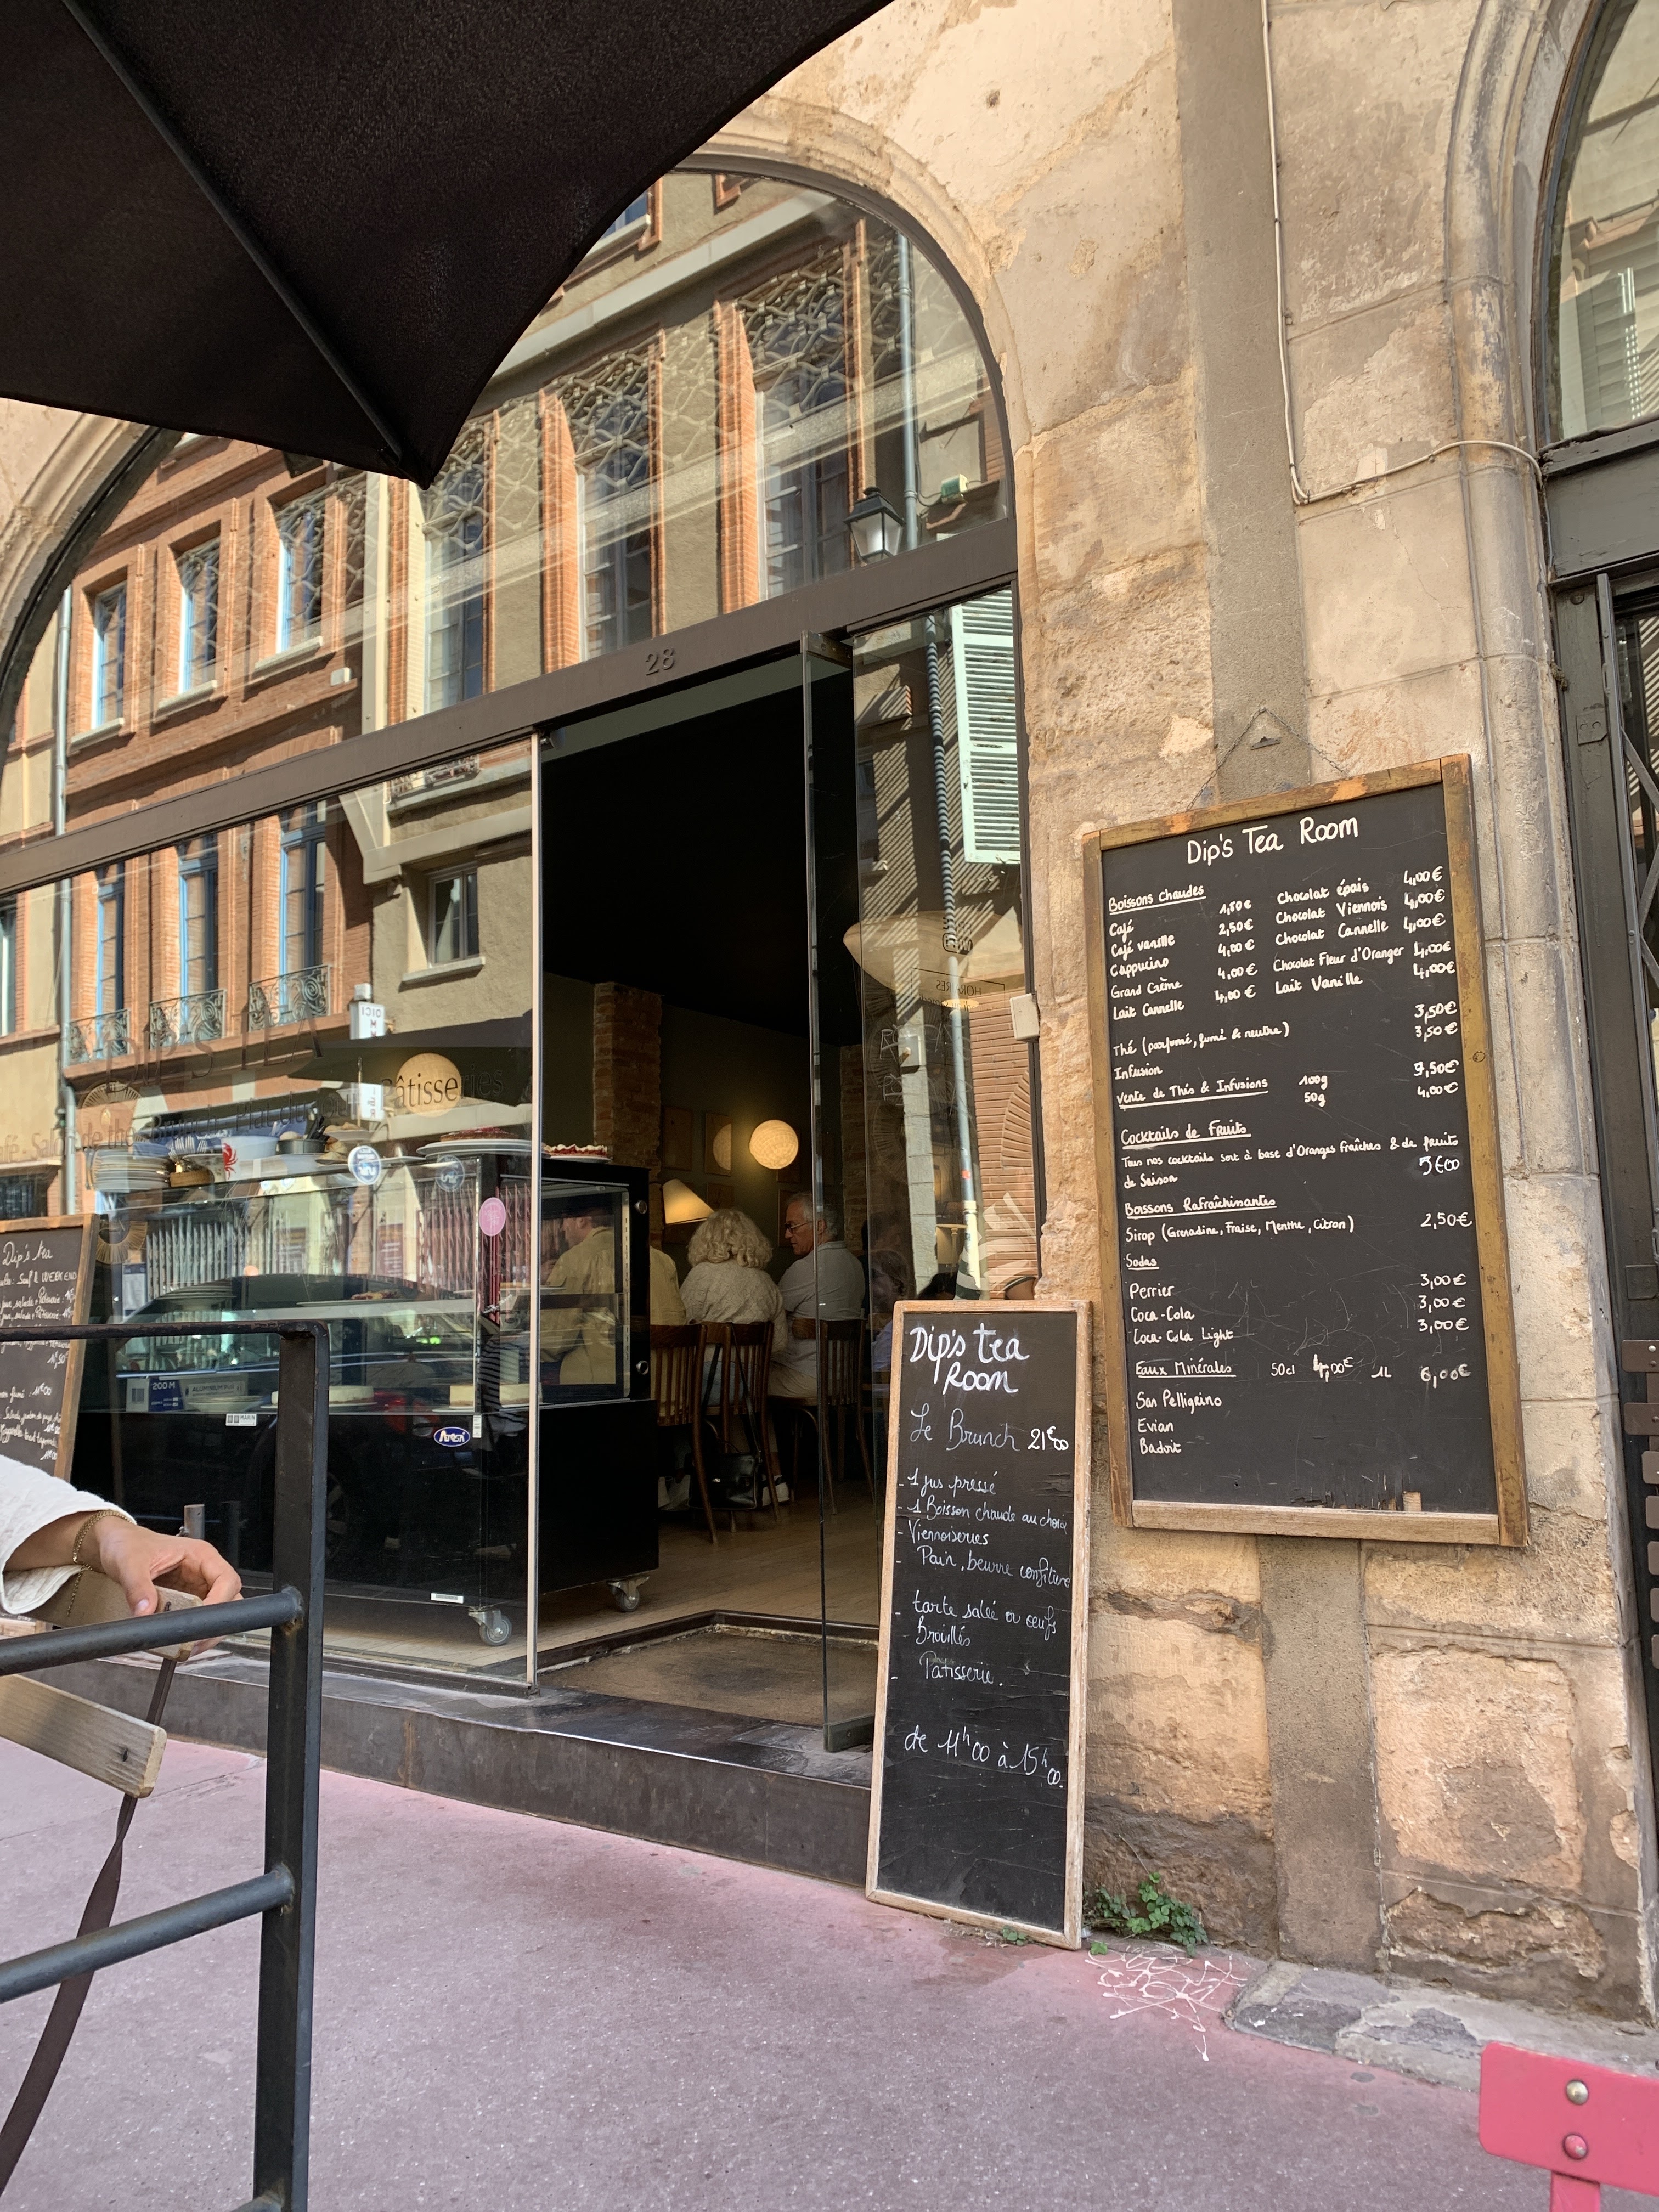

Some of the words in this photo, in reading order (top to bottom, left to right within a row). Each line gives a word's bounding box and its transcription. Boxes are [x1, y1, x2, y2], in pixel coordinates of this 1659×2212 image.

[646, 648, 675, 676] 28
[1187, 833, 1233, 866] Dip's
[1242, 824, 1284, 855] Tea
[1300, 816, 1359, 845] Room
[1108, 894, 1154, 912] Boissons
[1158, 884, 1205, 902] chaudes
[1277, 887, 1330, 905] Chocolat
[1336, 877, 1370, 898] épais
[1403, 866, 1443, 887] 4,00€
[1276, 907, 1326, 925] Chocolat
[1335, 896, 1388, 917] Viennois
[1403, 888, 1446, 910] 4,00€
[1109, 918, 1135, 943] Café
[1111, 940, 1135, 961] Café
[1218, 918, 1254, 937] 2,50€
[1275, 928, 1325, 946] Chocolat
[1338, 919, 1389, 938] Cannelle
[1403, 912, 1447, 934] 4,00€
[1218, 939, 1255, 958] 4,00€
[1273, 957, 1316, 973] Chocolat
[1318, 951, 1347, 967] Fleur
[1350, 946, 1404, 965] d'Oranger
[1413, 940, 1452, 959] 4,00€
[1111, 984, 1142, 999] Grand
[1217, 963, 1259, 980] 4,00€
[1275, 979, 1302, 995] Lait
[1311, 972, 1364, 992] Vanille
[1413, 961, 1456, 980] 4,00€
[1113, 1005, 1137, 1021] Lait
[1142, 1000, 1185, 1017] Cannelle
[1214, 985, 1257, 1005] 4,00€
[1113, 1040, 1138, 1057] Thé
[1231, 1028, 1242, 1040] &
[1414, 1001, 1458, 1025] 3,50€
[1114, 1062, 1164, 1080] Infusion
[1414, 1022, 1459, 1043] 3,50€
[1117, 1092, 1147, 1105] Vente
[1153, 1087, 1165, 1099] de
[1169, 1082, 1195, 1097] Thés
[1200, 1080, 1210, 1093] &
[1216, 1077, 1269, 1093] Infusions
[1298, 1074, 1329, 1090] 100g
[1304, 1091, 1327, 1107] 50g
[1417, 1081, 1459, 1098] 4,00€
[1120, 1125, 1180, 1146] Cocktails
[1185, 1123, 1201, 1139] de
[1121, 1156, 1143, 1169] Tous
[1146, 1156, 1164, 1166] nos
[1168, 1151, 1214, 1166] cocktails
[1244, 1148, 1253, 1160] à
[1257, 1147, 1282, 1160] base
[1285, 1144, 1336, 1160] d'Oranges
[1340, 1137, 1381, 1154] fraîches
[1390, 1136, 1400, 1150] &
[1402, 1136, 1417, 1148] de
[1124, 1173, 1137, 1189] de
[1125, 1227, 1155, 1246] Sirop
[1224, 1220, 1262, 1235] Fraise,
[1420, 1211, 1473, 1230] 2,50€
[1125, 1253, 1158, 1268] Sodas
[1130, 1282, 1175, 1300] Perrier
[1420, 1273, 1467, 1290] 3,00€
[1131, 1306, 1195, 1323] Coca-Cola
[1418, 1295, 1466, 1314] 3,00€
[1201, 1327, 1234, 1348] Light
[1417, 1317, 1470, 1334] 3,00€
[909, 1325, 966, 1385] Dip's
[972, 1322, 1030, 1364] tea
[941, 1361, 1019, 1395] Room
[1136, 1360, 1168, 1376] Eaux
[1175, 1357, 1232, 1375] Minérales
[1270, 1362, 1296, 1377] 50cl
[1313, 1353, 1354, 1383] 4,00€
[1420, 1363, 1471, 1389] 6,00€
[1136, 1391, 1158, 1410] San
[910, 1402, 933, 1442] Le
[945, 1408, 1021, 1452] Brunch
[1137, 1417, 1174, 1434] Evian
[920, 1475, 944, 1498] jus
[948, 1471, 998, 1498] pressé
[926, 1494, 970, 1521] Boisson
[975, 1501, 1016, 1522] chaude
[1022, 1513, 1037, 1526] au
[1019, 1557, 1071, 1588] confiture
[912, 1589, 958, 1618] tarte
[1005, 1611, 1021, 1625] ou
[904, 1724, 929, 1753] de
[997, 1741, 1009, 1769] à
